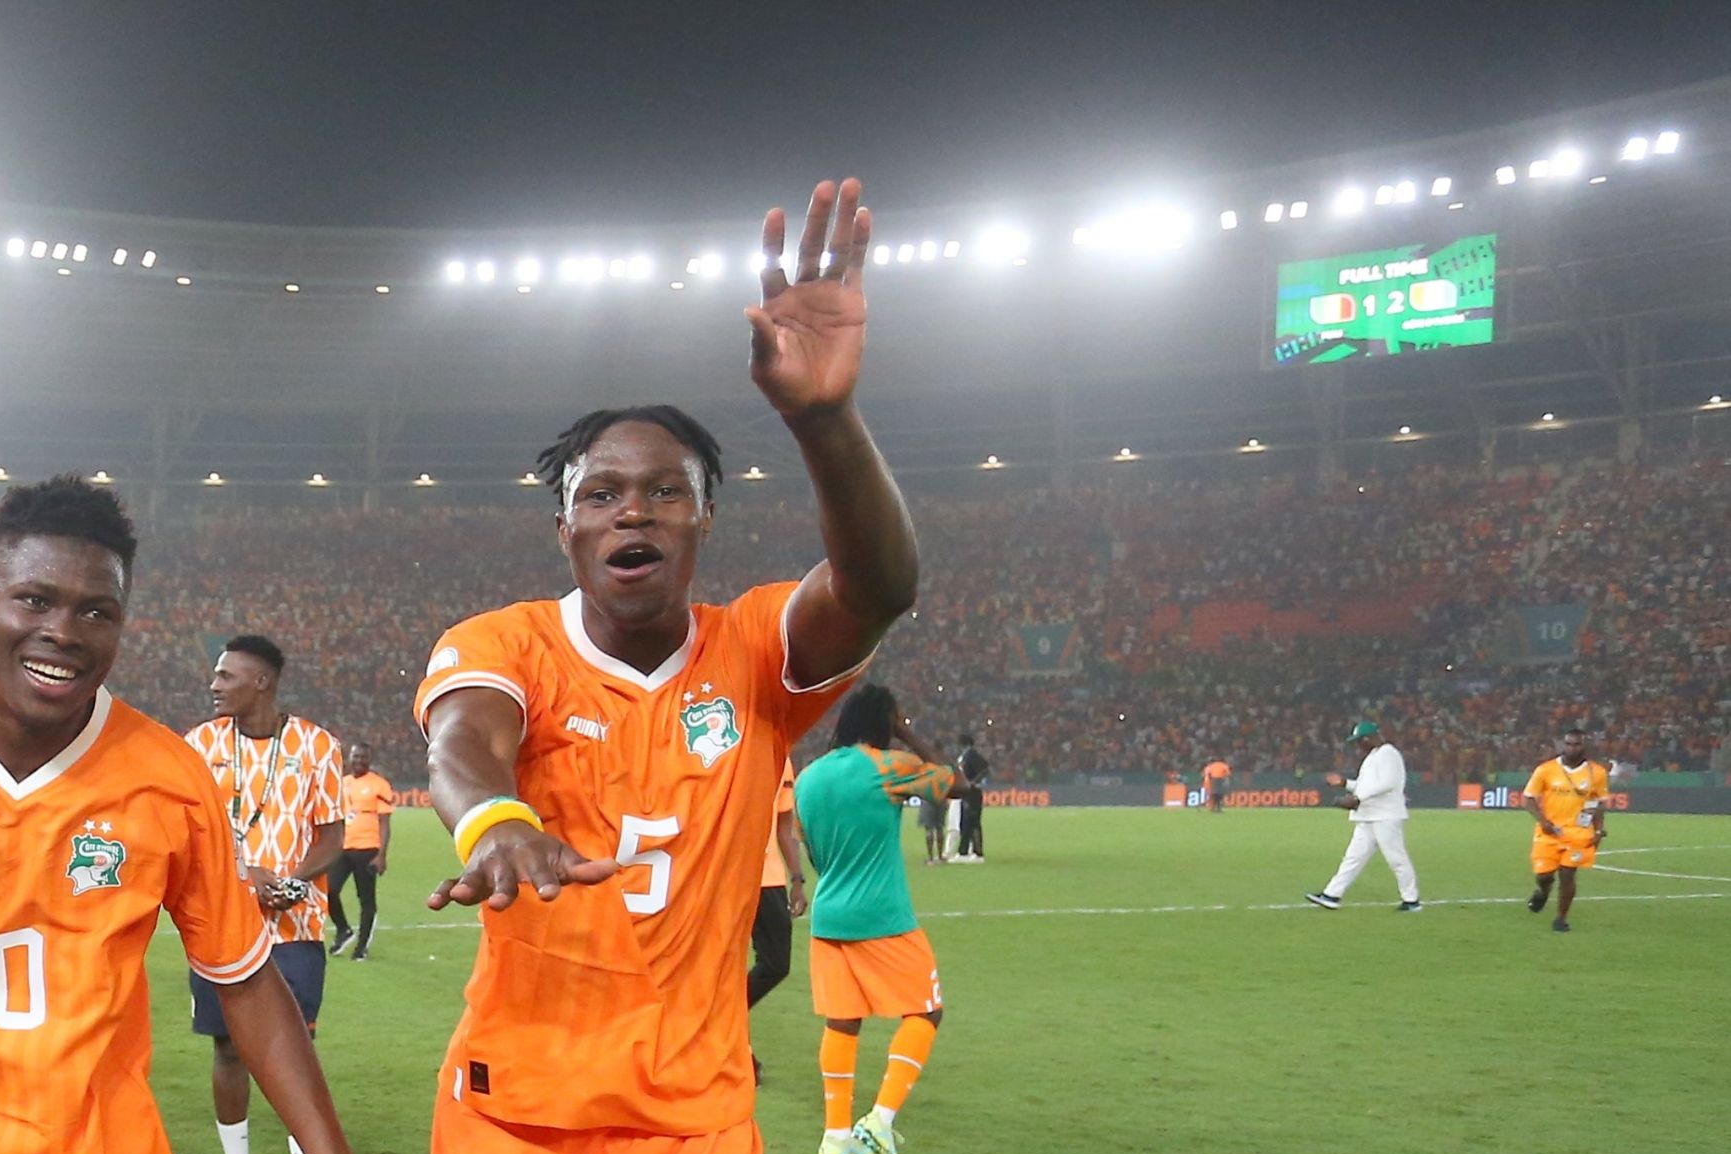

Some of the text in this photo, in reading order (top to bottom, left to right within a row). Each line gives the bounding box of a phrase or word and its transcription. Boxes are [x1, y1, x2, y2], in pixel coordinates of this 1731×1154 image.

[1339, 258, 1429, 285] FULL TIME
[1363, 290, 1405, 316] 1 2
[615, 814, 680, 915] 5
